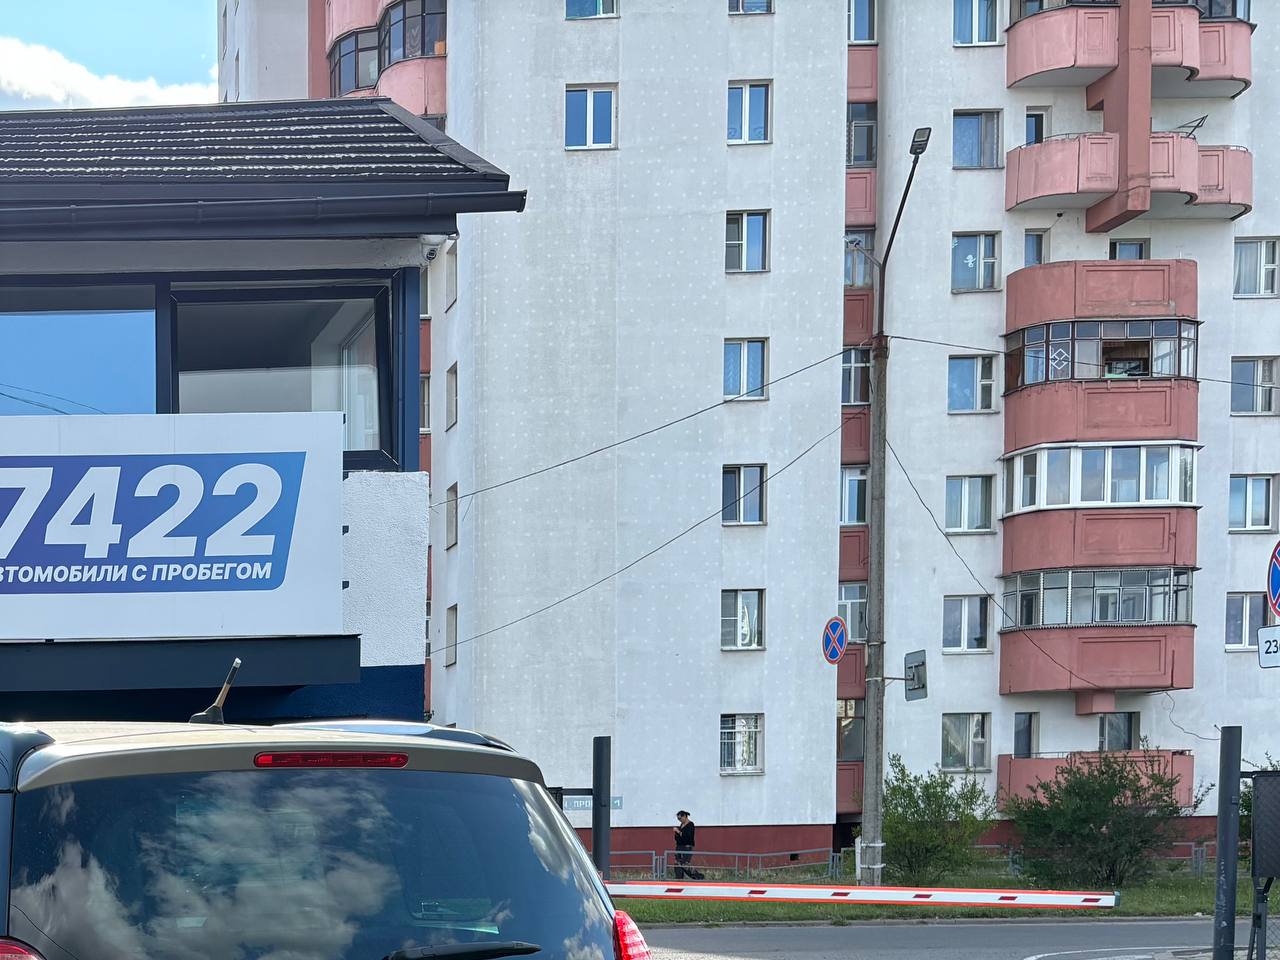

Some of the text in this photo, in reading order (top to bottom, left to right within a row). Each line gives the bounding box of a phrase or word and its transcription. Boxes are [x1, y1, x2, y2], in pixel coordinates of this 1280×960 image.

[131, 564, 147, 581] С
[151, 562, 272, 581] ПРОБЕГОМ
[1264, 639, 1280, 655] 23
